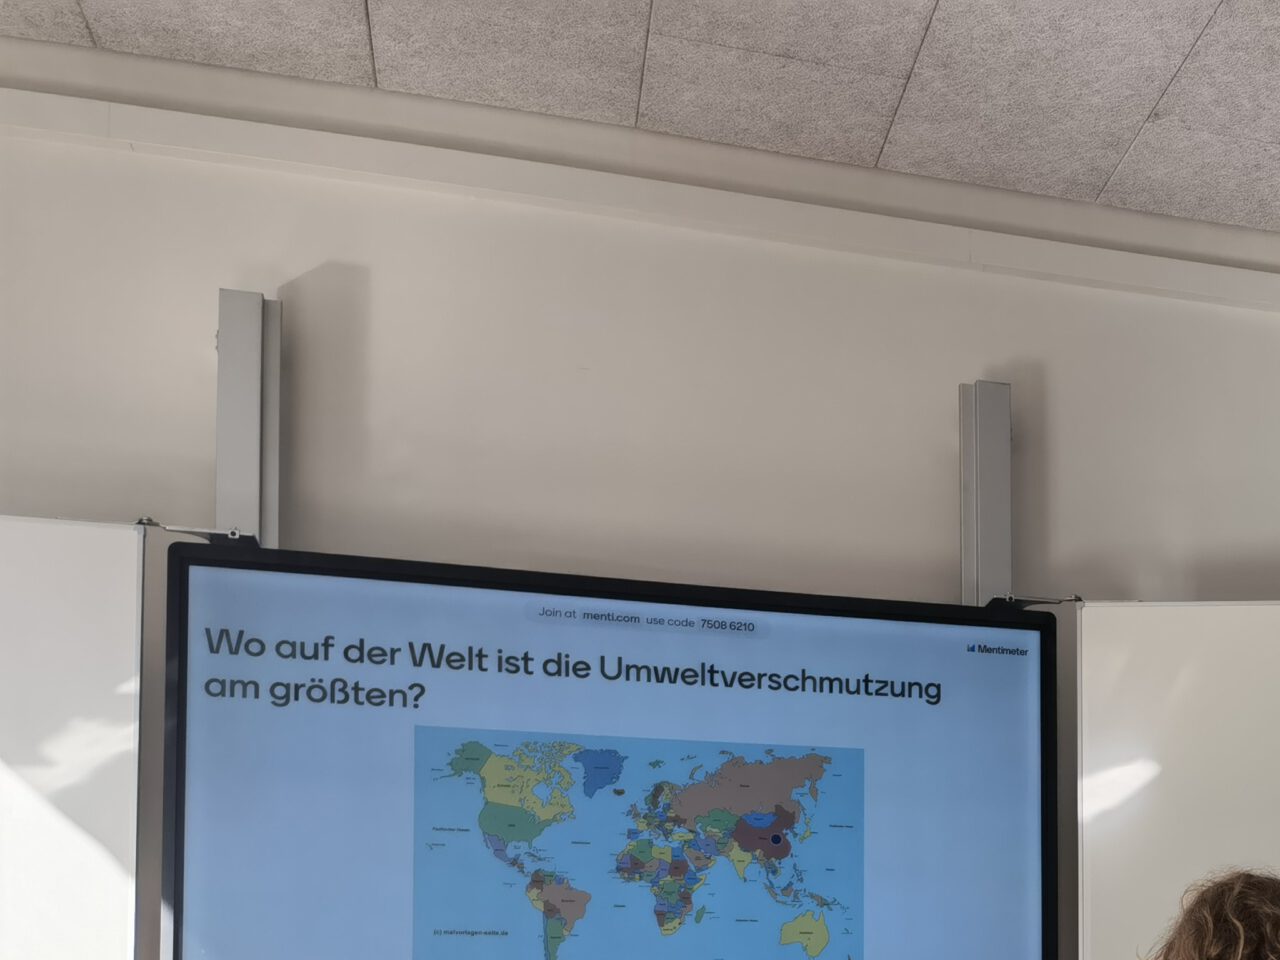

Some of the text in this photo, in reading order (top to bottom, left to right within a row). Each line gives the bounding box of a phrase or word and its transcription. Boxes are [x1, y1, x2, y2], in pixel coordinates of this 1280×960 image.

[538, 606, 755, 632] Join at menti.com use code 7508 6210
[977, 643, 1030, 657] Mentimeter
[204, 626, 943, 706] Wo auf der Welt ist die Umweltverschmutzung
[204, 676, 427, 709] am größten?
